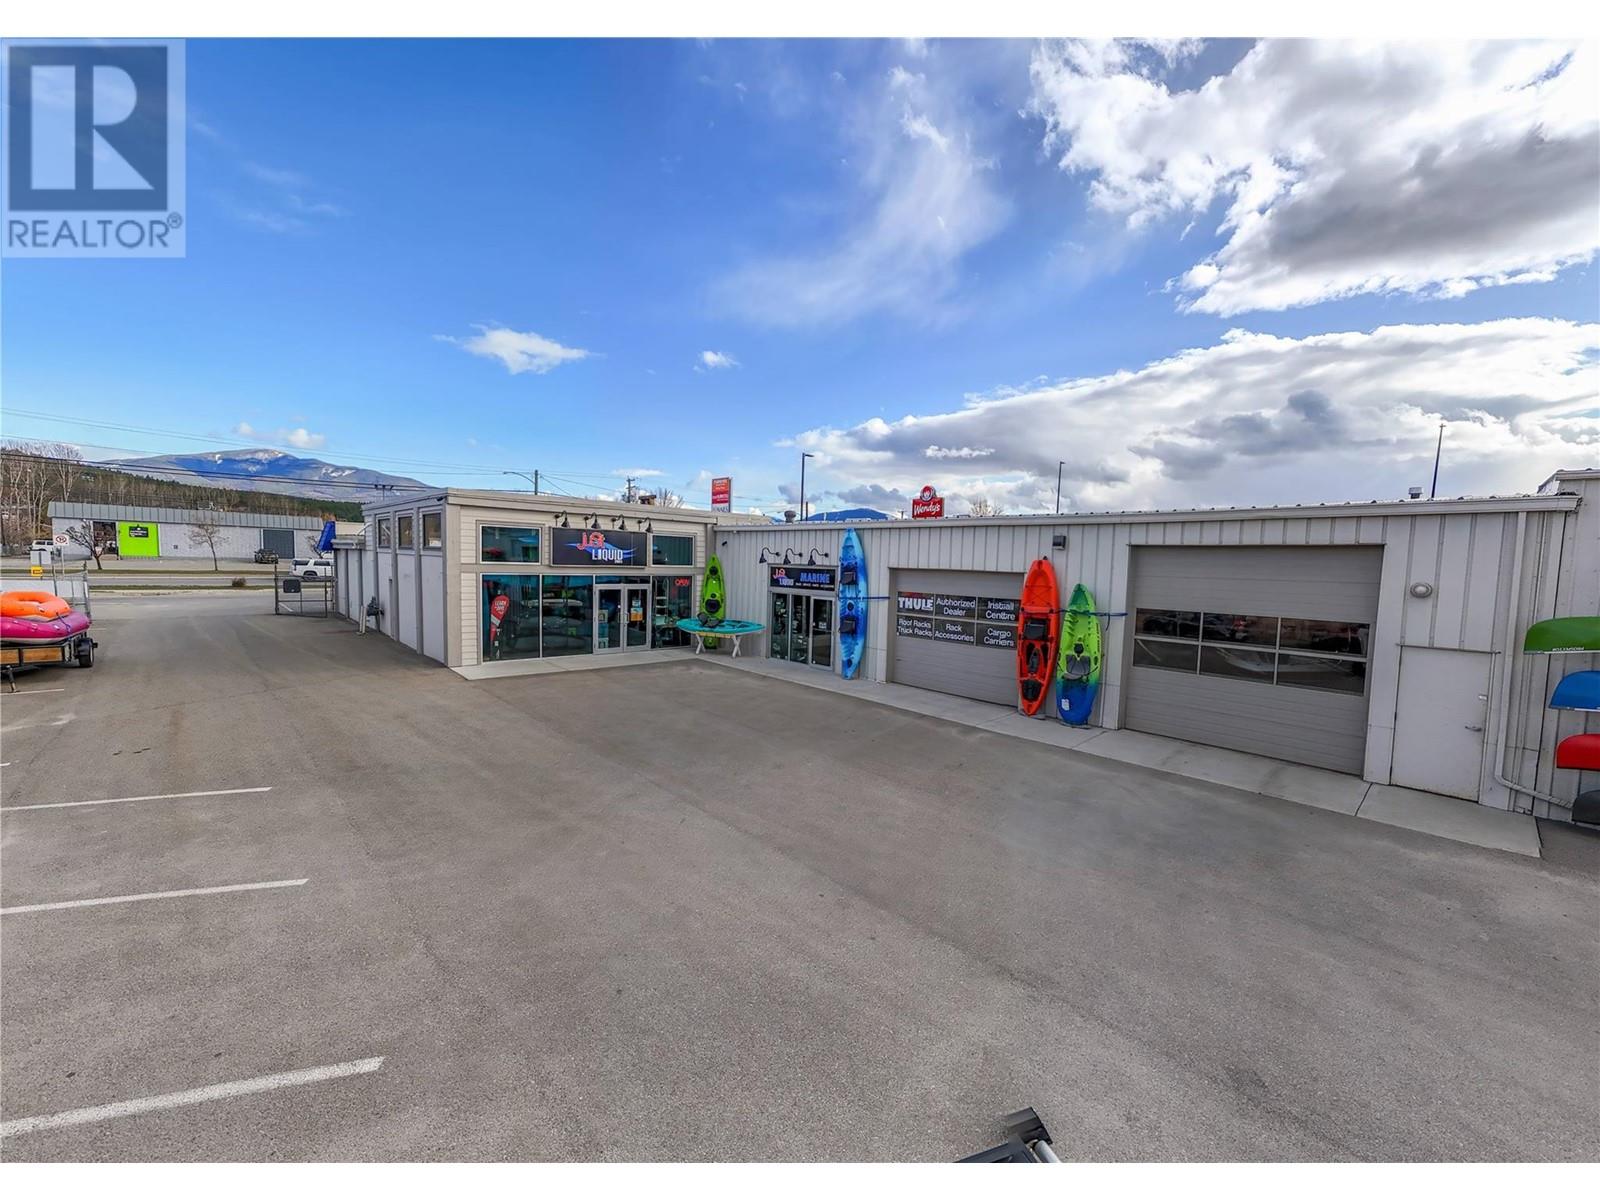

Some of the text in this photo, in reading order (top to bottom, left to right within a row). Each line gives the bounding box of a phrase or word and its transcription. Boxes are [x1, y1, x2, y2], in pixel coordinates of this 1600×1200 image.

[913, 501, 941, 515] Wendy's
[591, 549, 624, 562] LIQUID
[800, 572, 830, 584] MARINE
[897, 596, 934, 611] THULE
[936, 597, 976, 609] Authorized
[987, 600, 1015, 611] Install
[943, 607, 967, 617] Dealer
[985, 610, 1016, 621] Centre
[898, 618, 932, 629] Roof Racks
[945, 623, 963, 632] Rack
[913, 627, 933, 637] Racks
[934, 630, 974, 643] Accessories
[987, 627, 1012, 639] Cargo
[983, 636, 1015, 647] Carriers
